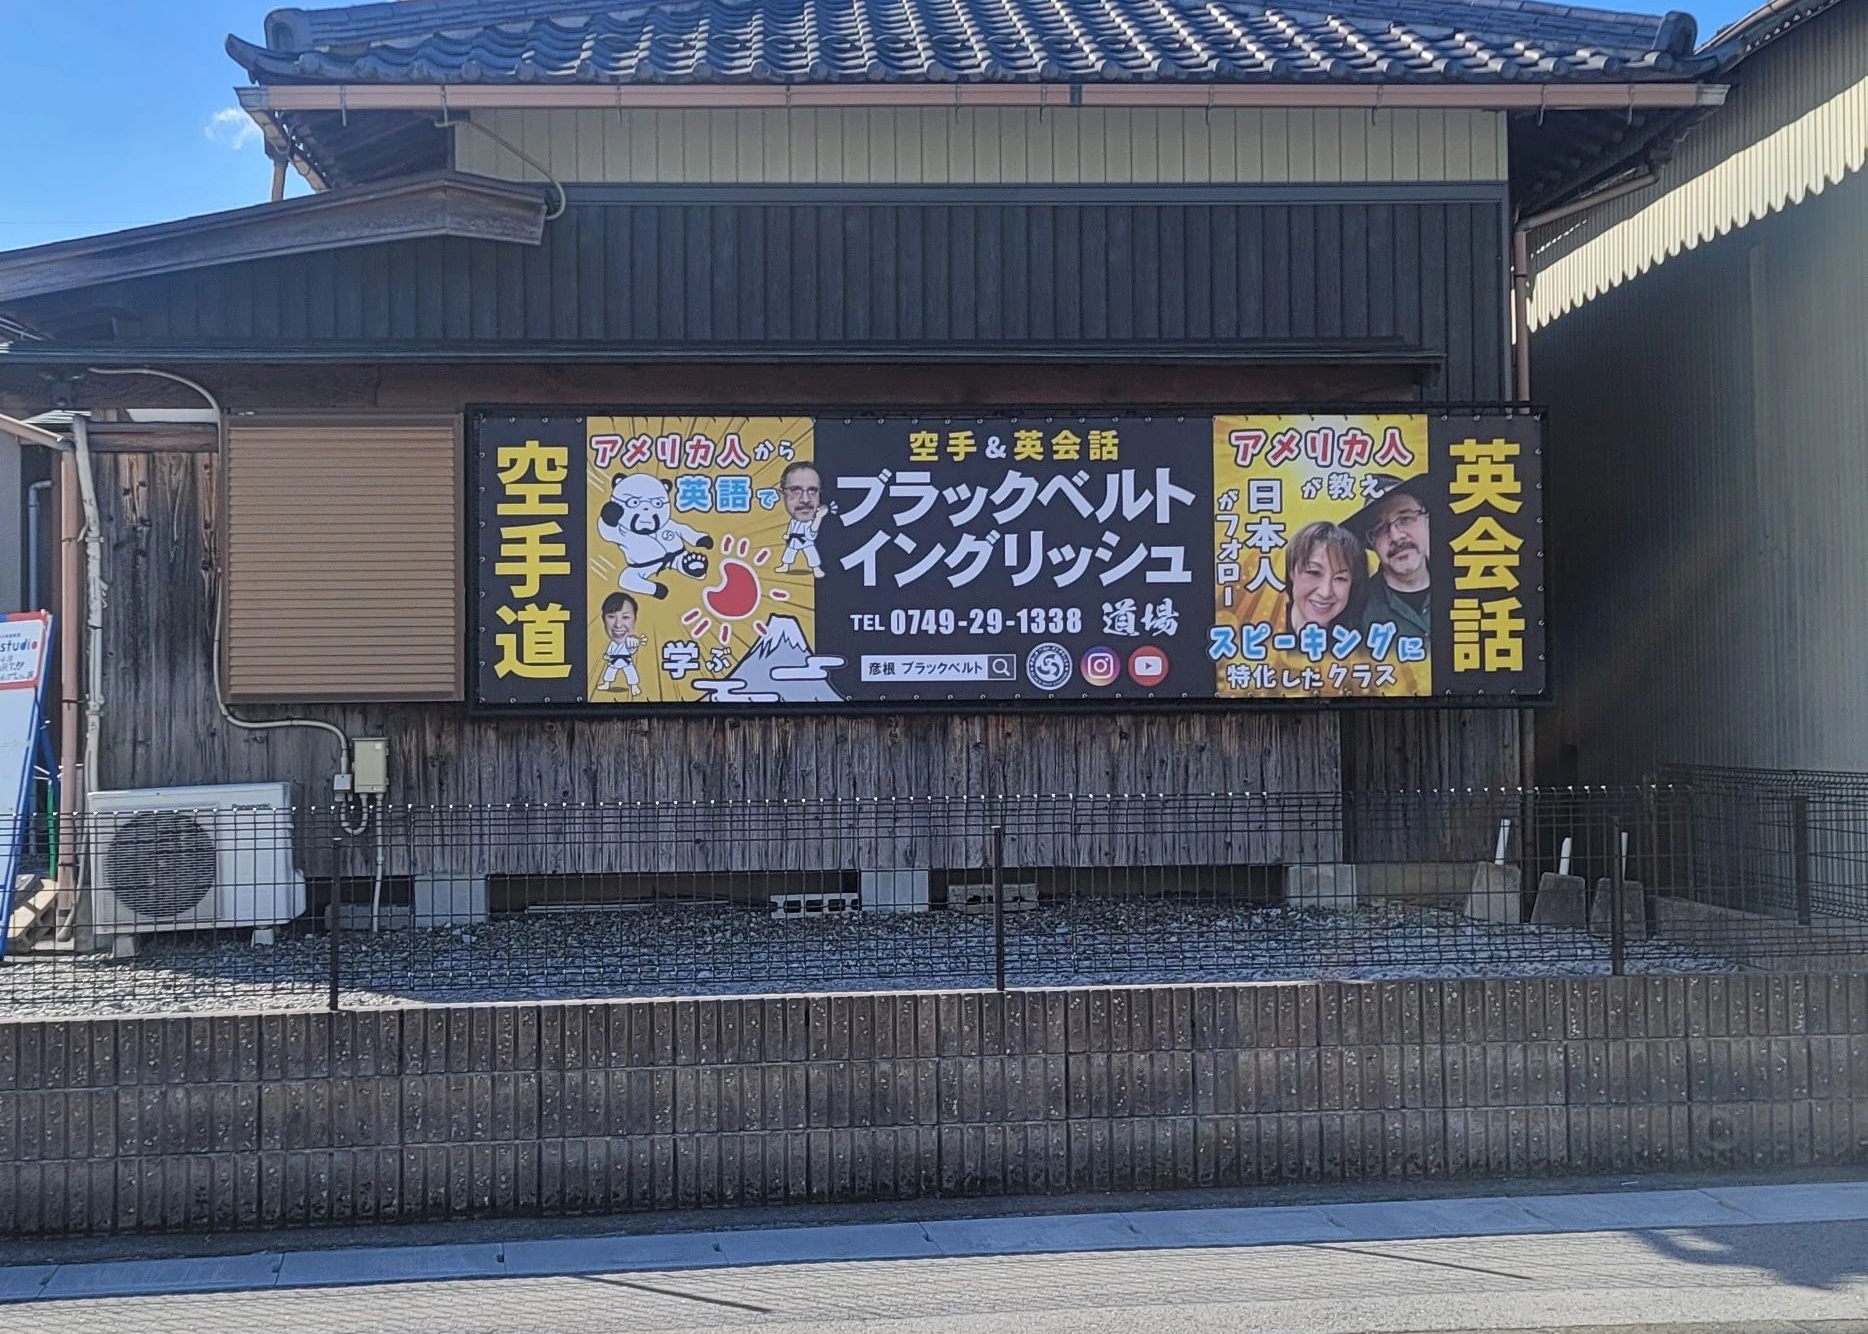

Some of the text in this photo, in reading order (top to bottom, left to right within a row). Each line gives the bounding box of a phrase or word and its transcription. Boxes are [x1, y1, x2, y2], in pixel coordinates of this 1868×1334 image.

[591, 433, 796, 468] アメリカ人から
[1230, 427, 1414, 467] アメリカ人
[676, 475, 779, 513] 英語で
[837, 468, 1197, 527] ブラックベルト
[1302, 473, 1386, 500] が教え
[1216, 489, 1242, 607] がフォロー
[1245, 478, 1286, 593] 日本人
[494, 440, 572, 679] 空手道
[839, 529, 1193, 588] イングリッシュ
[1449, 438, 1526, 673] 英会話
[850, 608, 1082, 635] TEL 0749-29-1338
[1102, 598, 1180, 637] 道場
[662, 641, 731, 679] 学ぶ
[1208, 621, 1427, 662] スピーキングに
[901, 661, 983, 675] ブラックベルト
[1227, 664, 1397, 690] 特化したクラス
